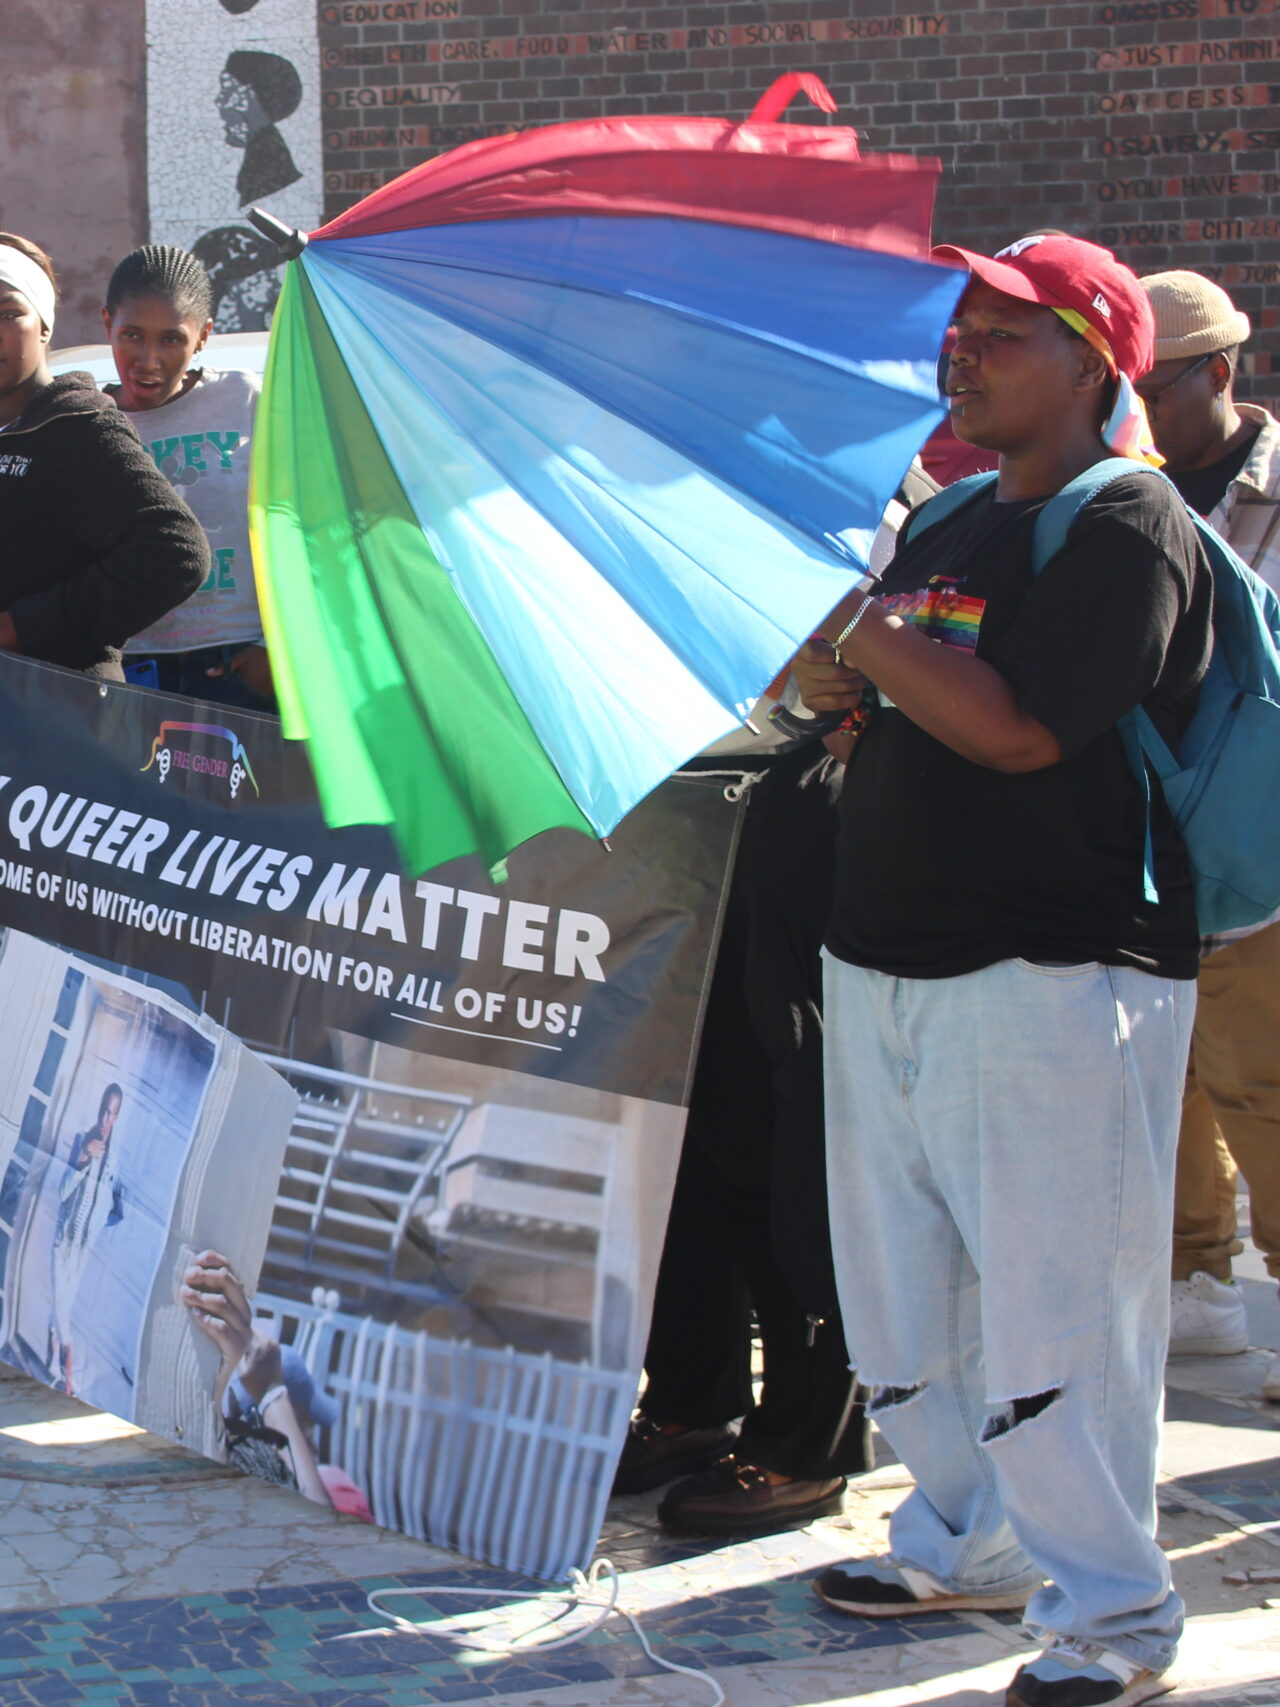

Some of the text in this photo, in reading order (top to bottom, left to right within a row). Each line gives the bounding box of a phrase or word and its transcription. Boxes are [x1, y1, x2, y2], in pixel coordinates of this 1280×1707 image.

[343, 1, 459, 23] EDUCATION
[1226, 0, 1257, 13] TO
[516, 36, 569, 55] FOOD
[587, 32, 668, 52] WATER
[687, 28, 728, 48] AND
[745, 23, 816, 45] SOCIAL
[845, 15, 945, 38] SECURITY
[1123, 44, 1178, 66] JUST
[344, 84, 460, 107] EQUALITY
[348, 127, 414, 148] HUMAN
[1120, 178, 1163, 199] YOU
[1183, 175, 1241, 196] HAVE
[1121, 222, 1182, 243] YOUR
[172, 750, 229, 778] FREE GENDER
[8, 785, 170, 875] QUEER
[158, 829, 314, 912] LIVES
[306, 862, 611, 982] MATTER
[36, 871, 62, 901] OF
[65, 878, 88, 911] US
[92, 887, 189, 940] WITHOUT
[189, 916, 333, 983] LIBERATION
[337, 955, 394, 998] FOR
[395, 972, 444, 1013] ALL
[454, 988, 506, 1023] OF
[515, 997, 583, 1037] US!
